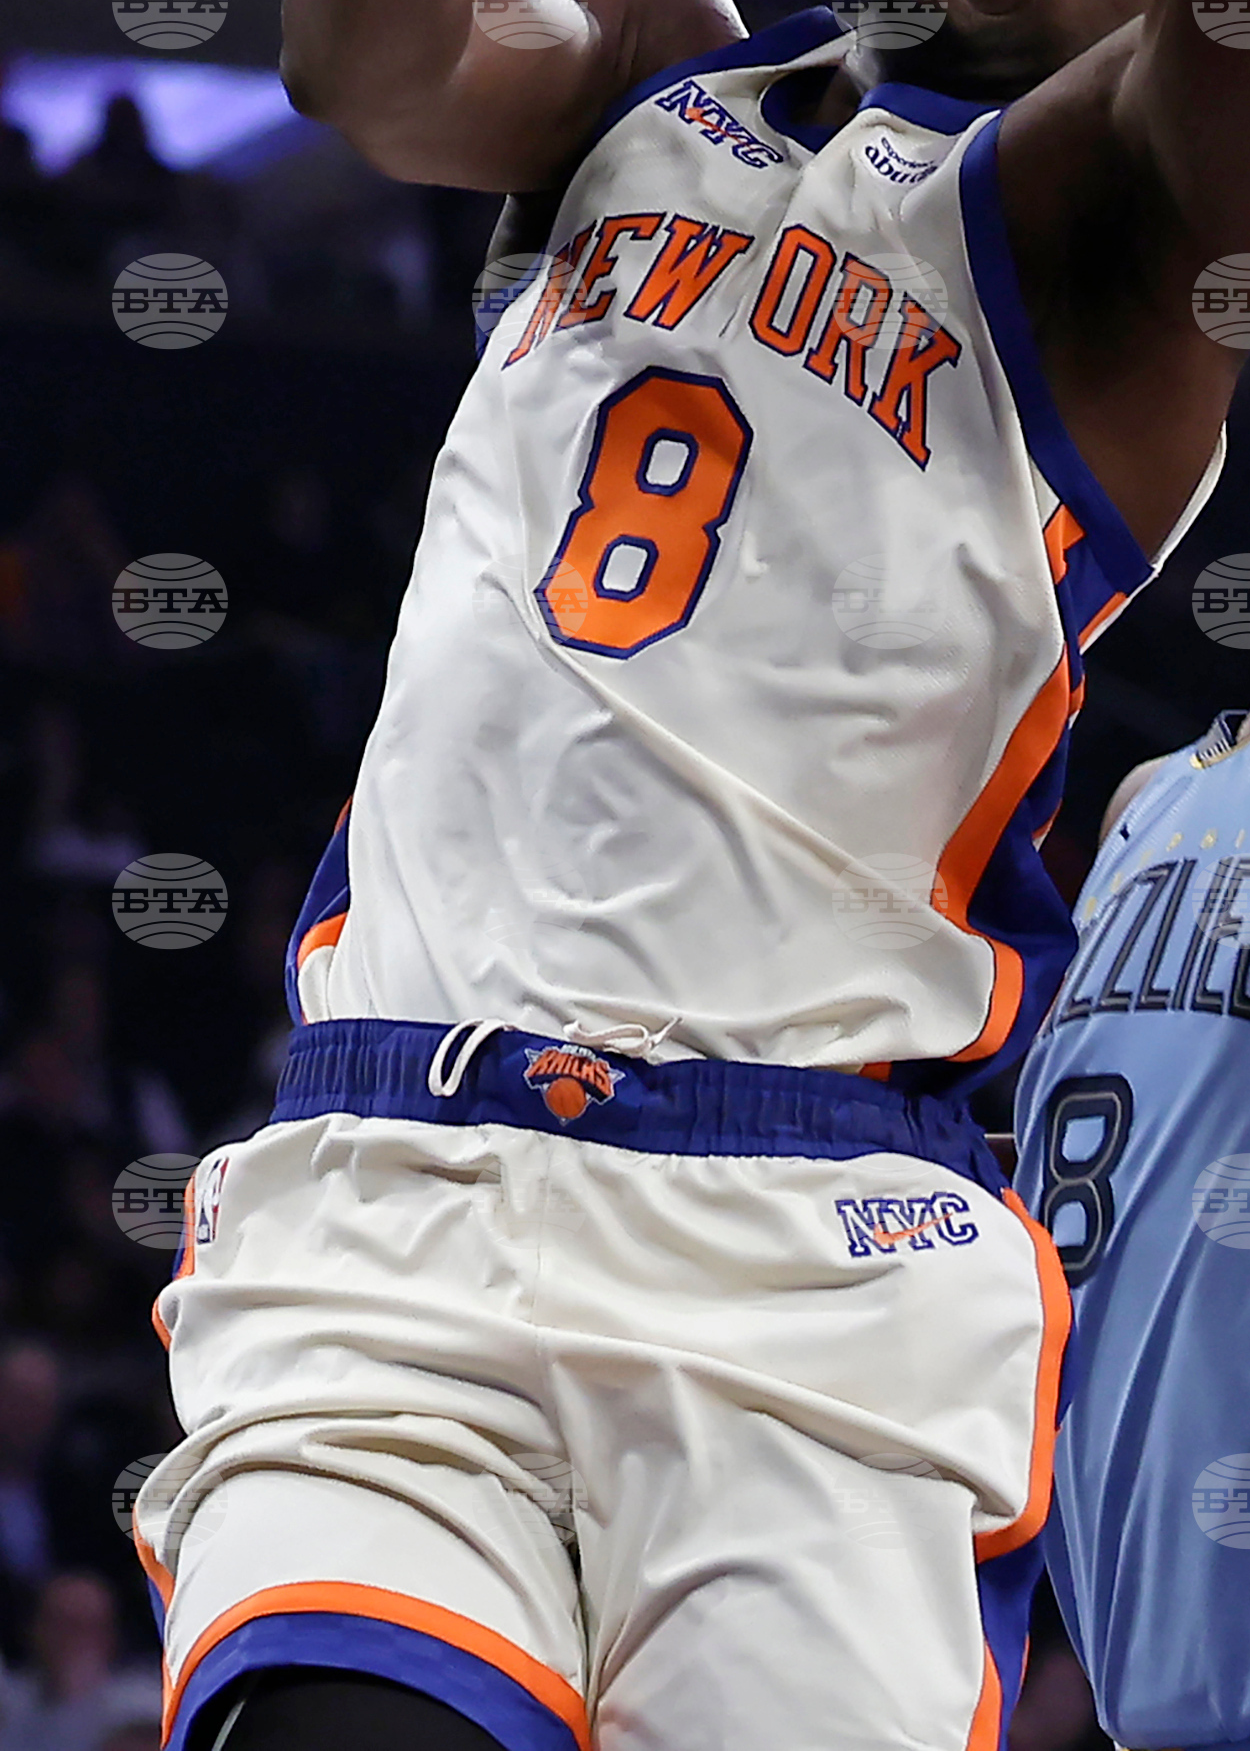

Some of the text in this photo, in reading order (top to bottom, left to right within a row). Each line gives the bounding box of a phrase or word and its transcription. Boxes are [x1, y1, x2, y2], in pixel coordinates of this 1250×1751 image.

[655, 79, 784, 168] NYC
[501, 211, 963, 472] NEW ORK
[534, 365, 754, 660] 8
[835, 1191, 979, 1258] NYC
[1039, 1072, 1134, 1289] 8
